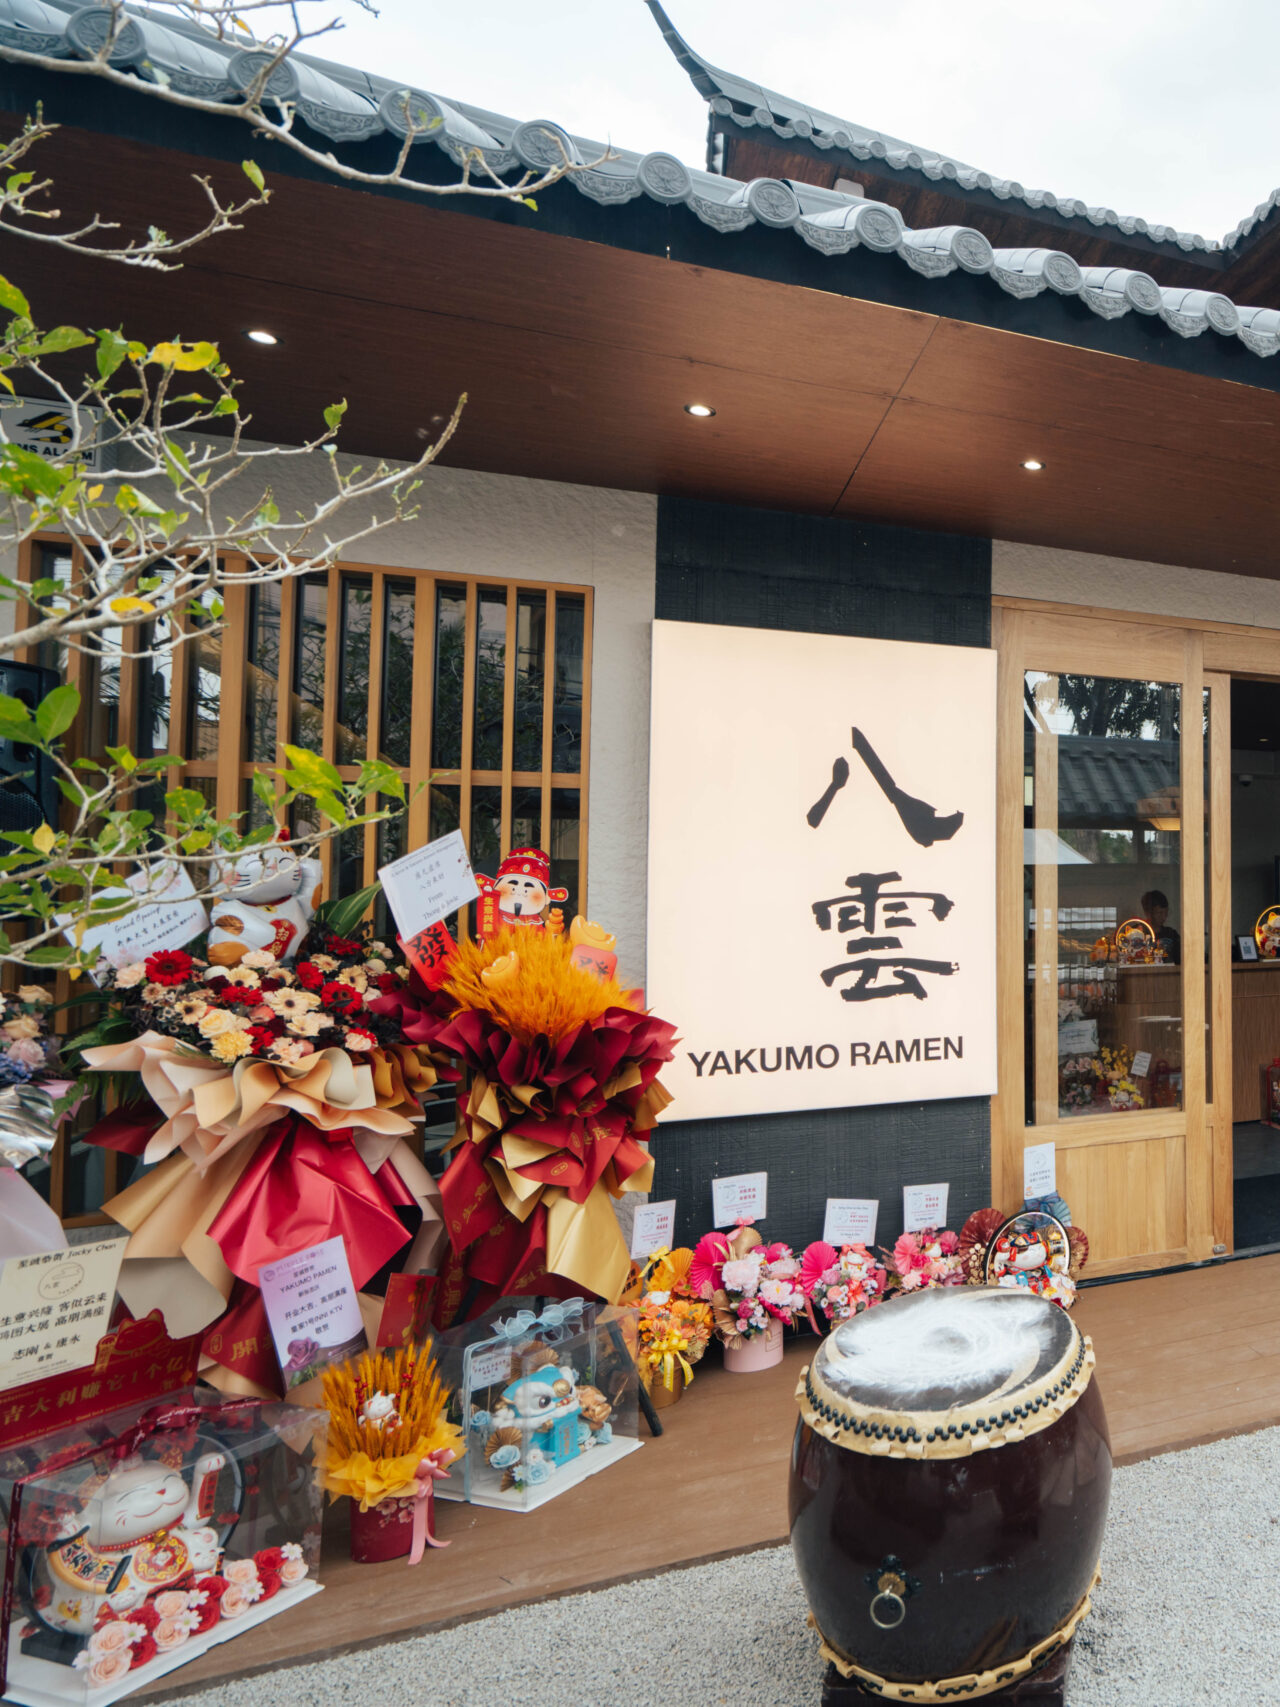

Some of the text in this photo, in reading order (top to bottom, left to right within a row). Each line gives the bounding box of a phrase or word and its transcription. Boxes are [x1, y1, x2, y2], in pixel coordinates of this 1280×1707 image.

[807, 726, 965, 1002] 八雲
[688, 1035, 964, 1078] YAKUMO RAMEN
[279, 1275, 313, 1294] YAKUMO
[329, 1304, 344, 1317] KTV
